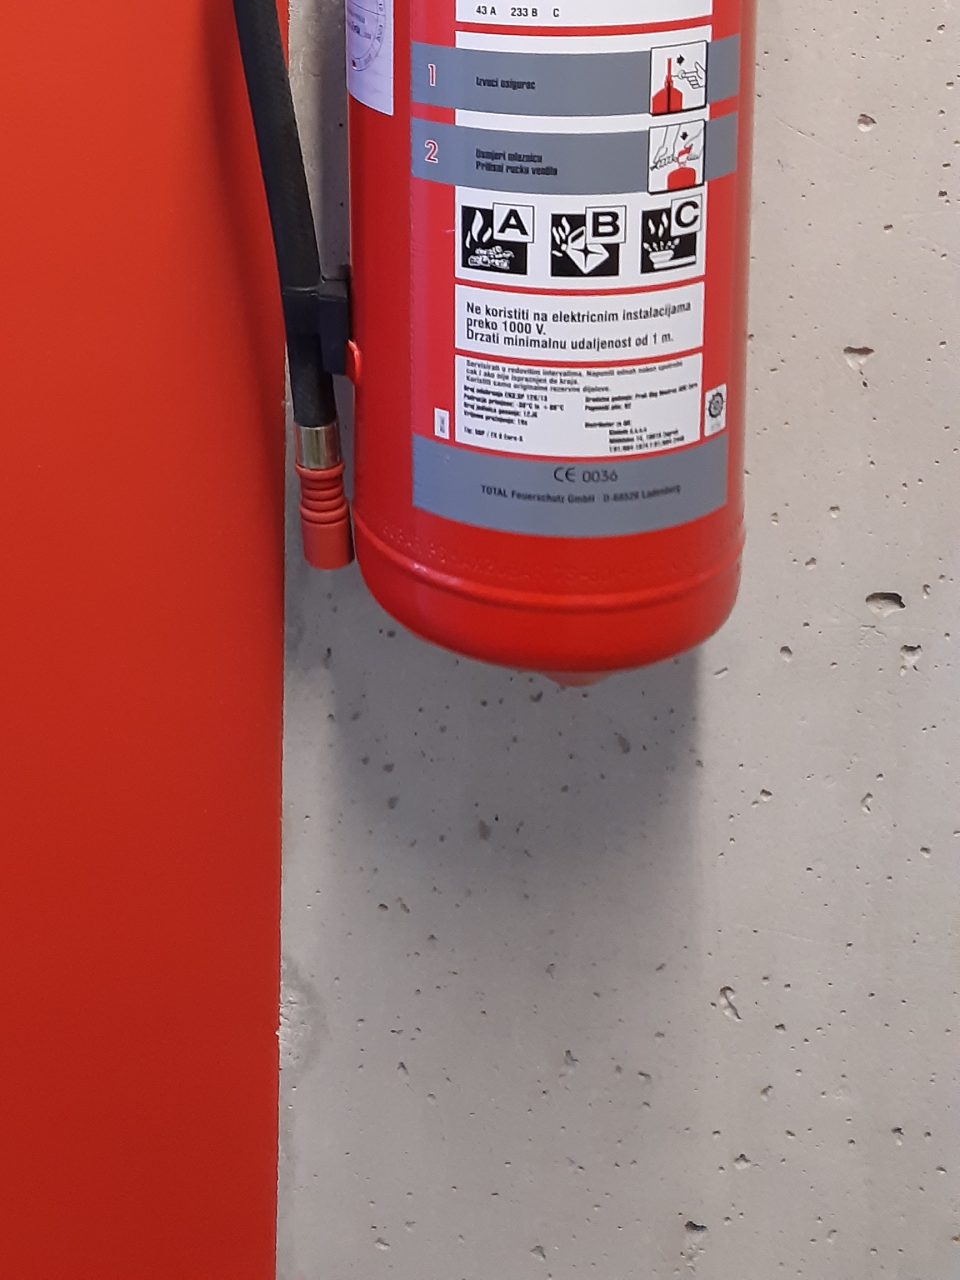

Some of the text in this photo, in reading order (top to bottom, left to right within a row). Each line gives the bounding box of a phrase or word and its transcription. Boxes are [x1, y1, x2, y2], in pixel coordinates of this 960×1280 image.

[476, 6, 561, 18] 43 A 233 B C
[427, 63, 436, 87] 1
[424, 139, 439, 164] 2
[498, 200, 699, 238] A B C
[466, 301, 691, 323] Ne koristiti na elektricnim instalacijama
[466, 317, 546, 336] preko 1000 V.
[466, 329, 500, 344] Drzati
[503, 335, 567, 350] minimalnu
[571, 335, 632, 351] udaljenost
[635, 333, 648, 347] od
[652, 332, 657, 345] 1
[582, 470, 618, 483] 0036
[480, 485, 508, 498] TOTAL
